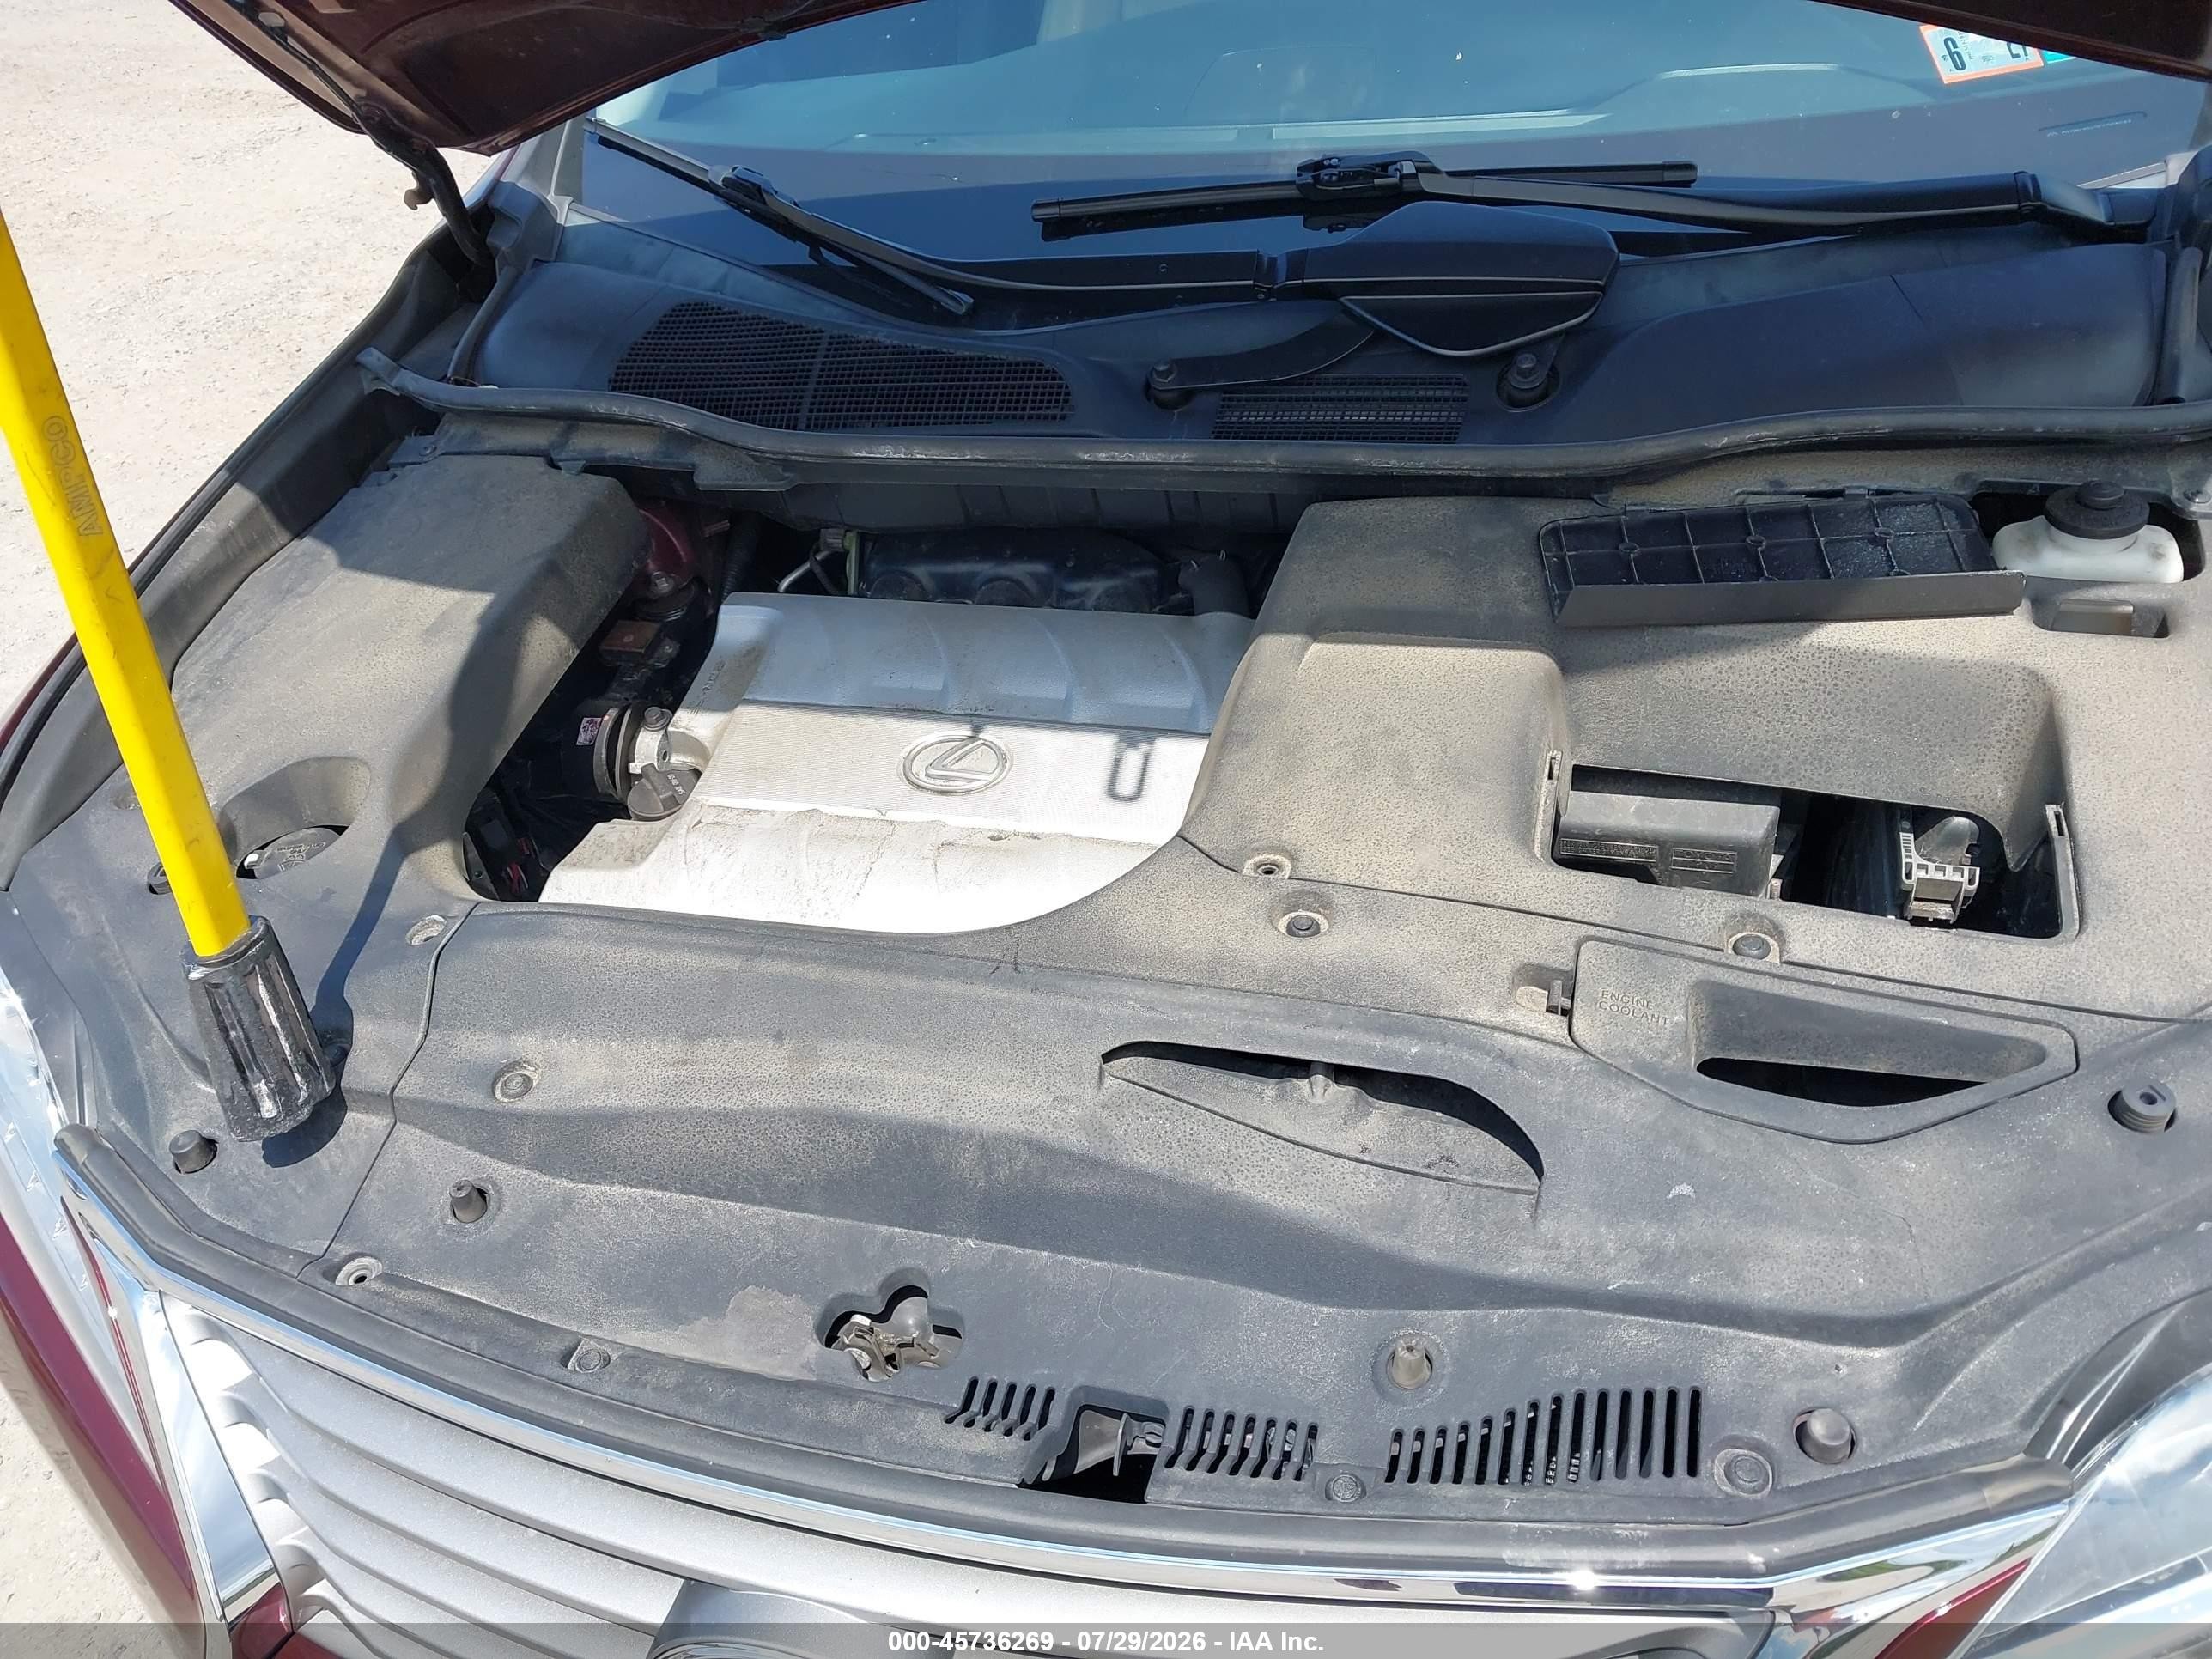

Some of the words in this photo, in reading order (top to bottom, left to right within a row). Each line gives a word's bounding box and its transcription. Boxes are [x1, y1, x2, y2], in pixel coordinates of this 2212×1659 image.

[1943, 36, 1966, 71] 6
[44, 416, 104, 537] AMPCO
[1598, 1000, 1670, 1026] COOLANT
[1601, 989, 1655, 1012] ENGINE
